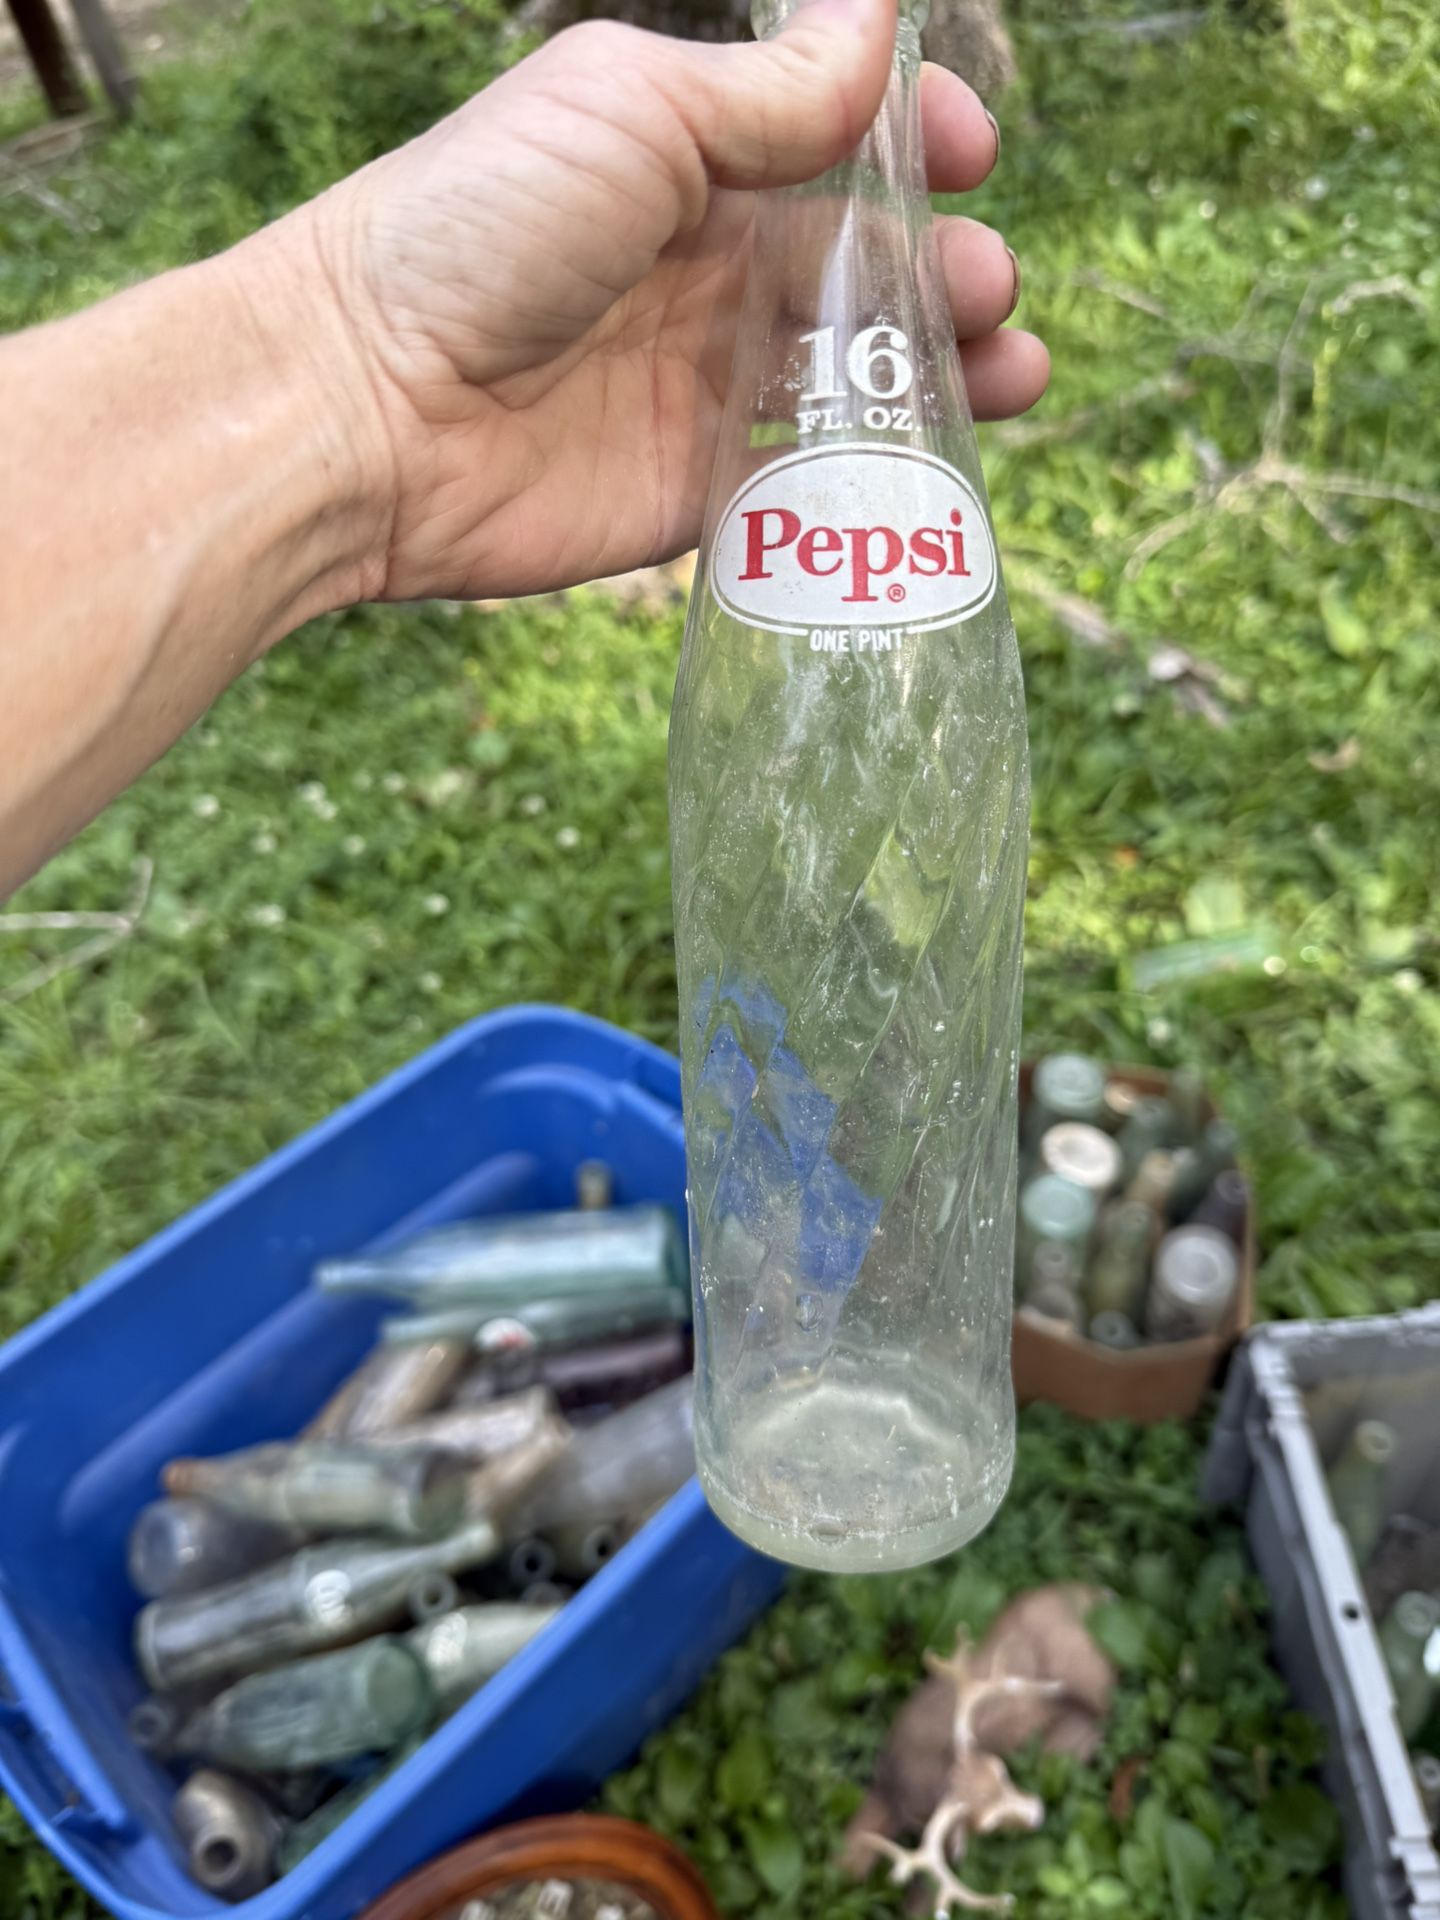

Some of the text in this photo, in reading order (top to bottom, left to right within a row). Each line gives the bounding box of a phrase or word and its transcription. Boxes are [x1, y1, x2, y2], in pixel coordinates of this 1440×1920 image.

[799, 325, 913, 400] 16
[796, 406, 922, 435] FL. OZ.
[738, 508, 971, 602] Pepsi
[809, 627, 904, 652] ONE PINT
